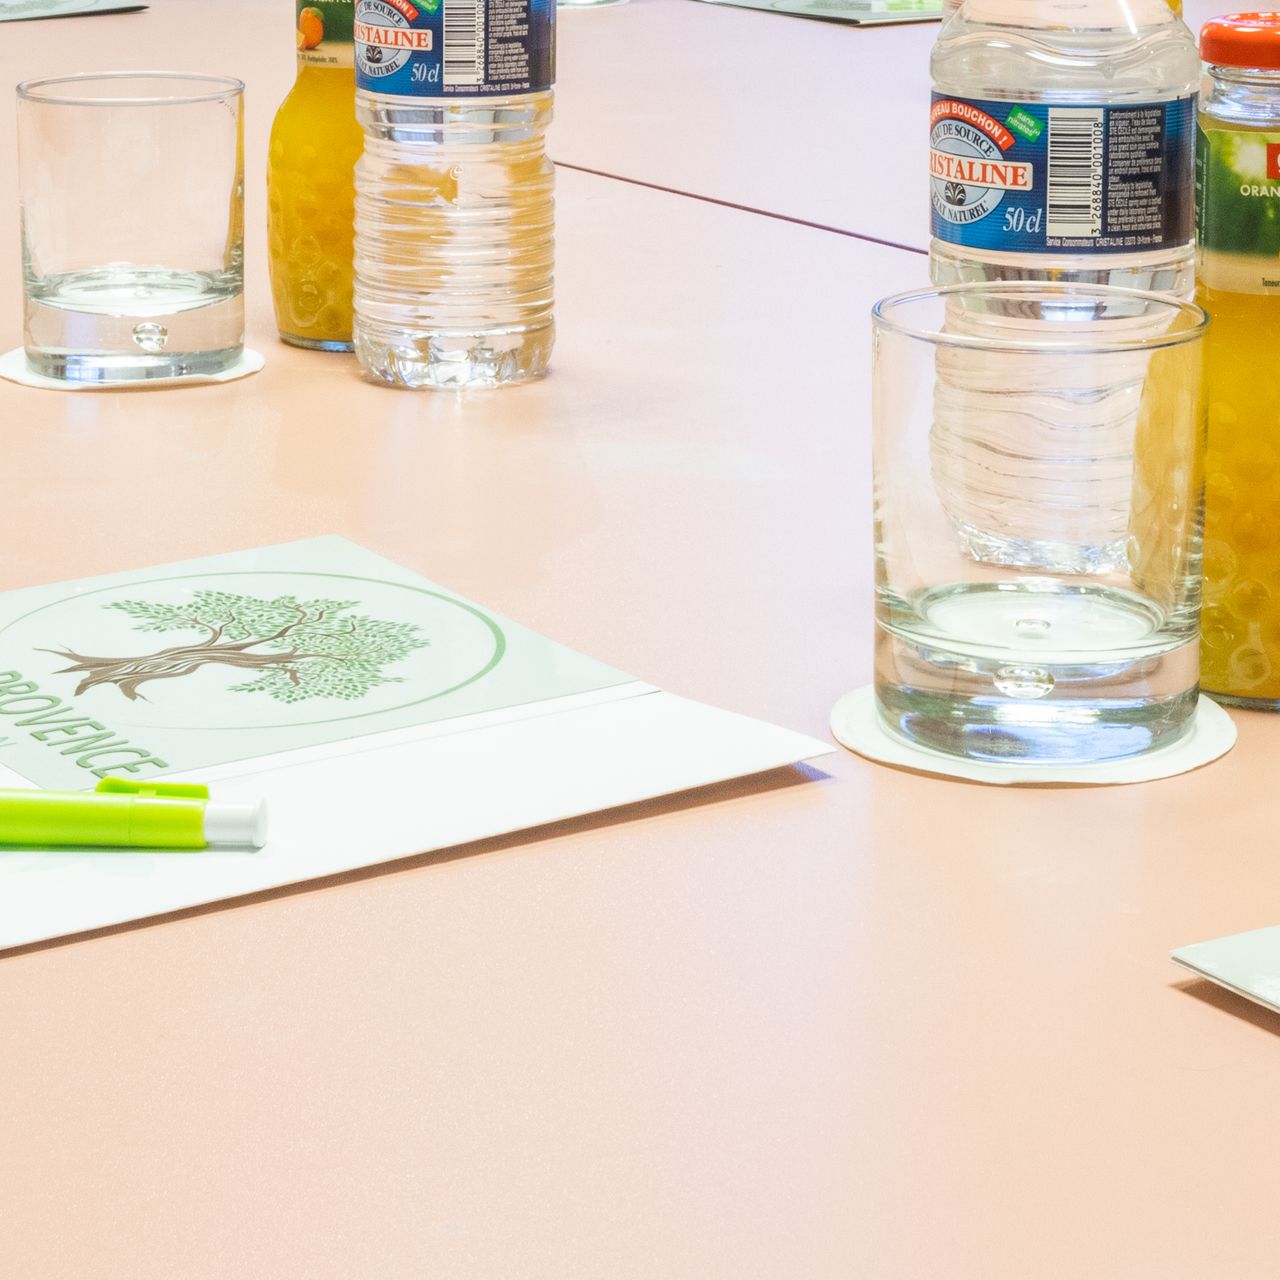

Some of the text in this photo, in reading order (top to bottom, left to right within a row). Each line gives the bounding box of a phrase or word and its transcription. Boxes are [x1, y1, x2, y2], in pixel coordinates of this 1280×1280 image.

[373, 2, 404, 25] SOURCE
[354, 23, 429, 48] ISTALINE
[367, 58, 401, 76] NATUREL
[410, 63, 440, 82] 50 cl
[932, 102, 951, 121] VEAU
[951, 103, 1003, 137] BOUCHON
[942, 123, 953, 136] DE
[954, 124, 995, 158] SOURCE
[1092, 121, 1104, 168] 001008
[1091, 173, 1103, 220] 268840
[947, 202, 989, 222] NATUREL
[1002, 207, 1043, 233] 50 cl
